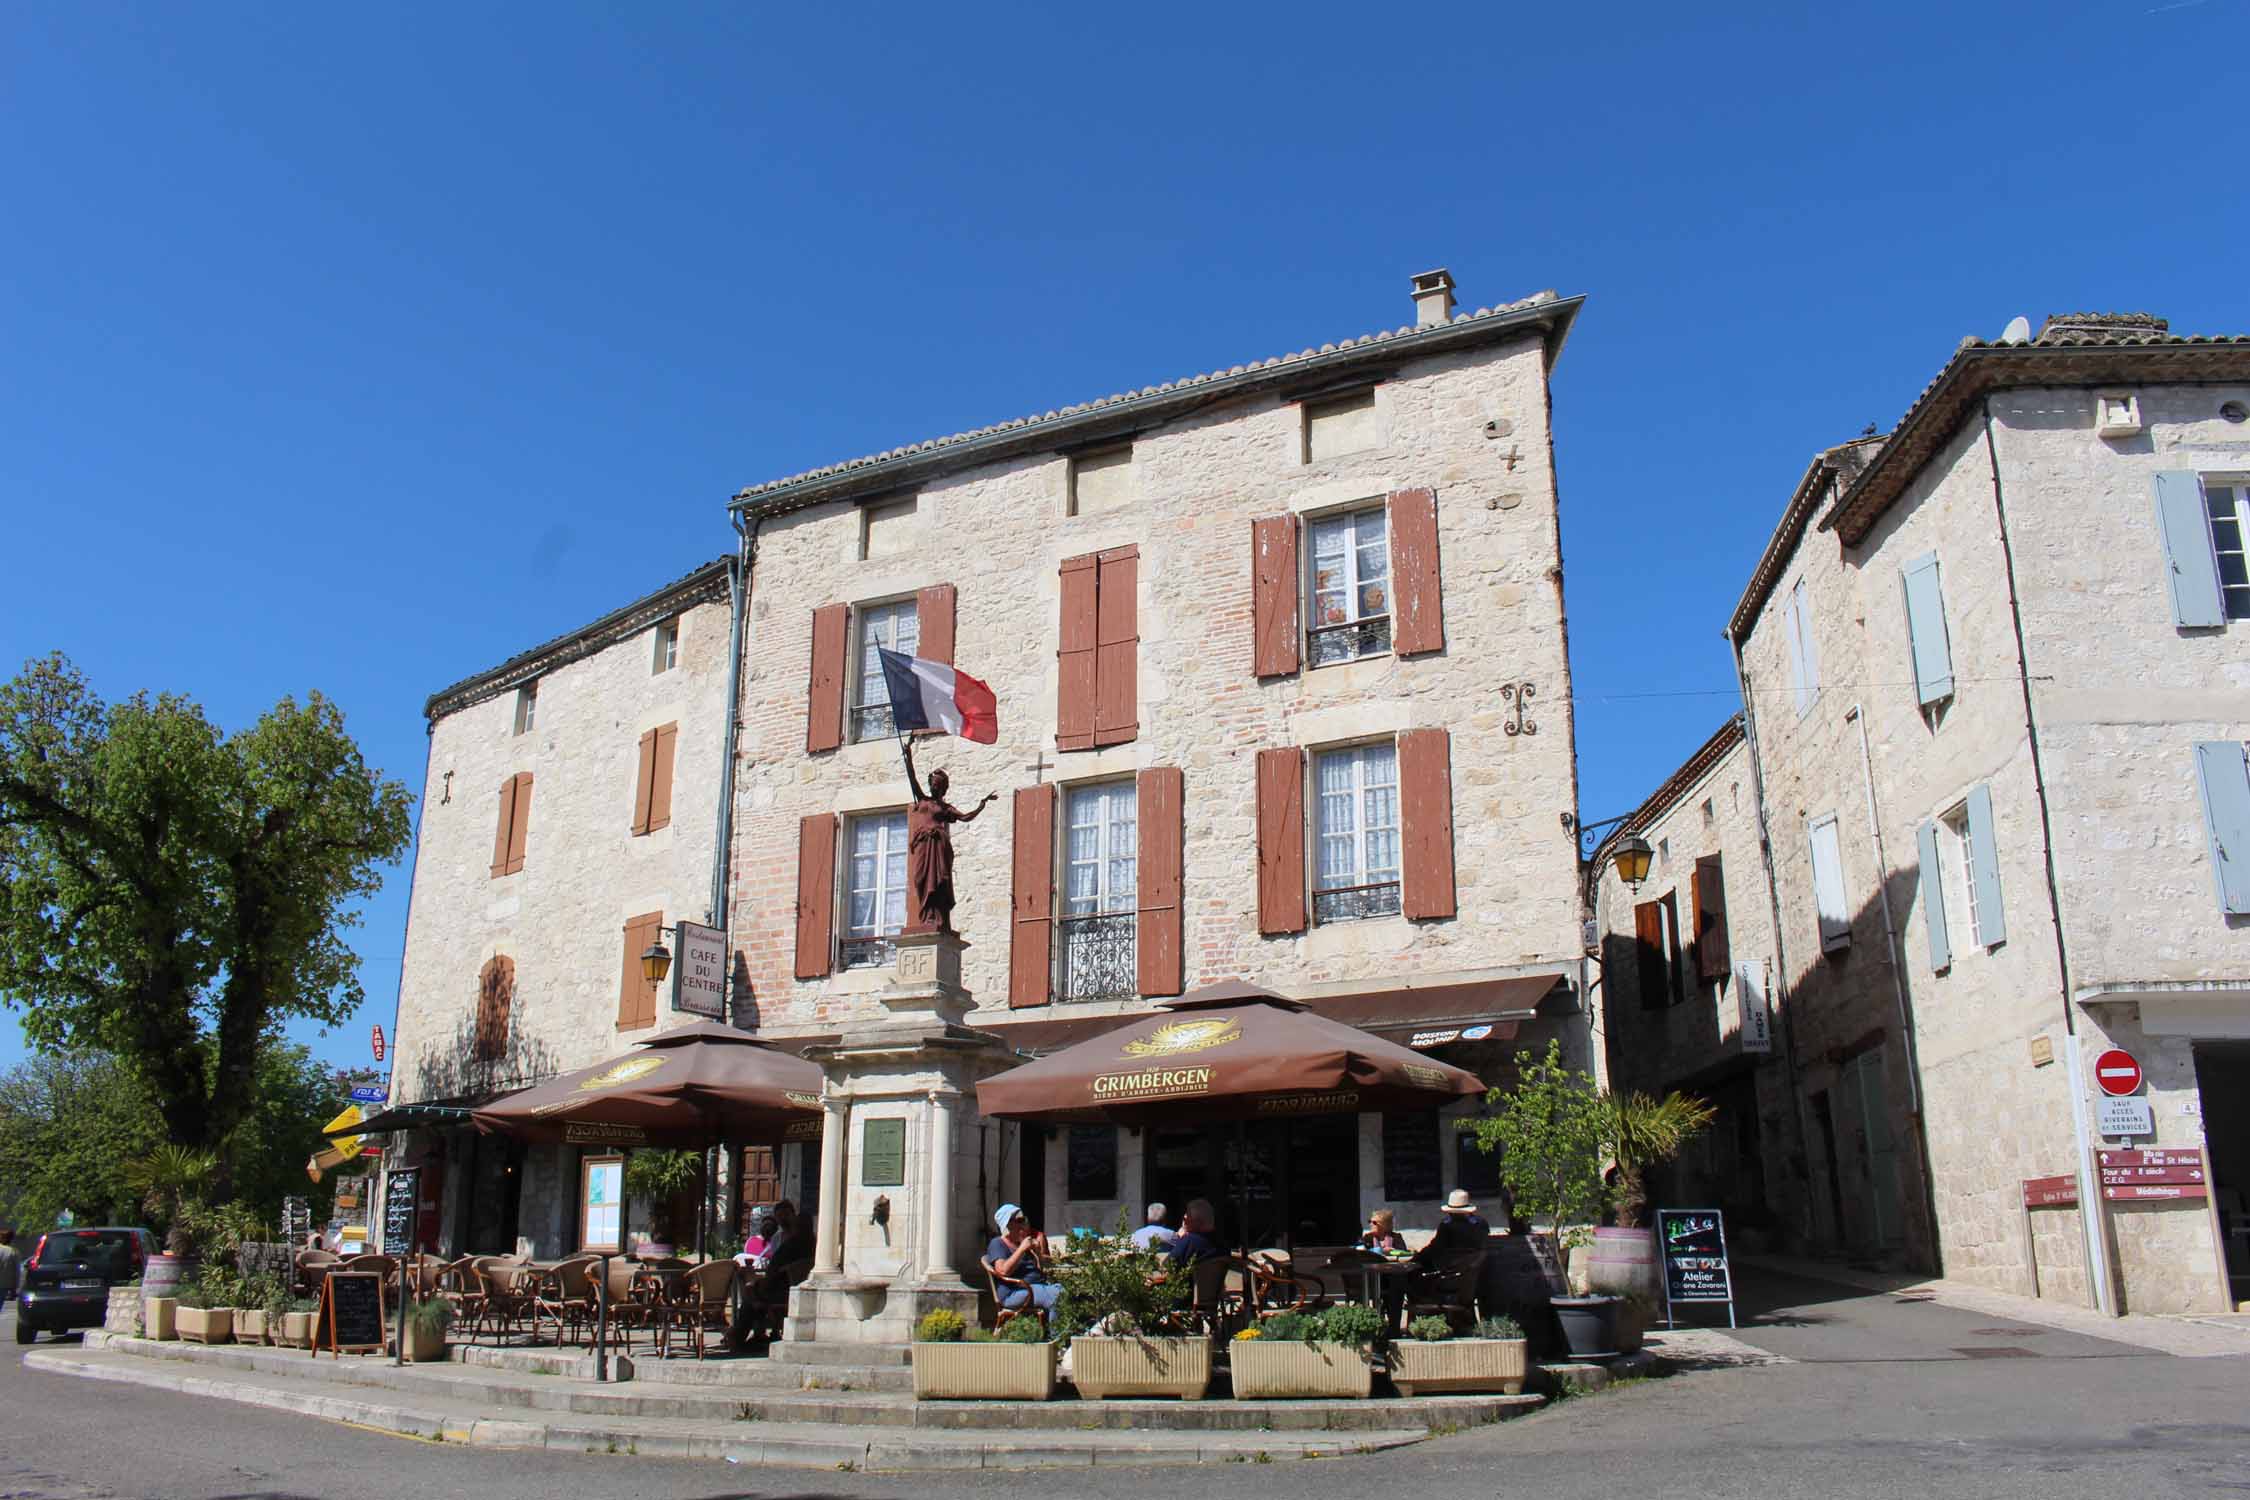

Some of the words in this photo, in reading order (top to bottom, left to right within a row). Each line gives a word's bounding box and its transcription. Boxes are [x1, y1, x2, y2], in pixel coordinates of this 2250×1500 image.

[690, 948, 717, 964] CAFE
[695, 965, 711, 977] DU
[682, 975, 723, 993] CENTRE
[373, 1026, 383, 1060] TABAC
[1094, 1069, 1210, 1093] GRIMBERGEN
[356, 1088, 371, 1096] FDJ
[2102, 1168, 2118, 1176] Tour
[1683, 1271, 1713, 1281] Atelier
